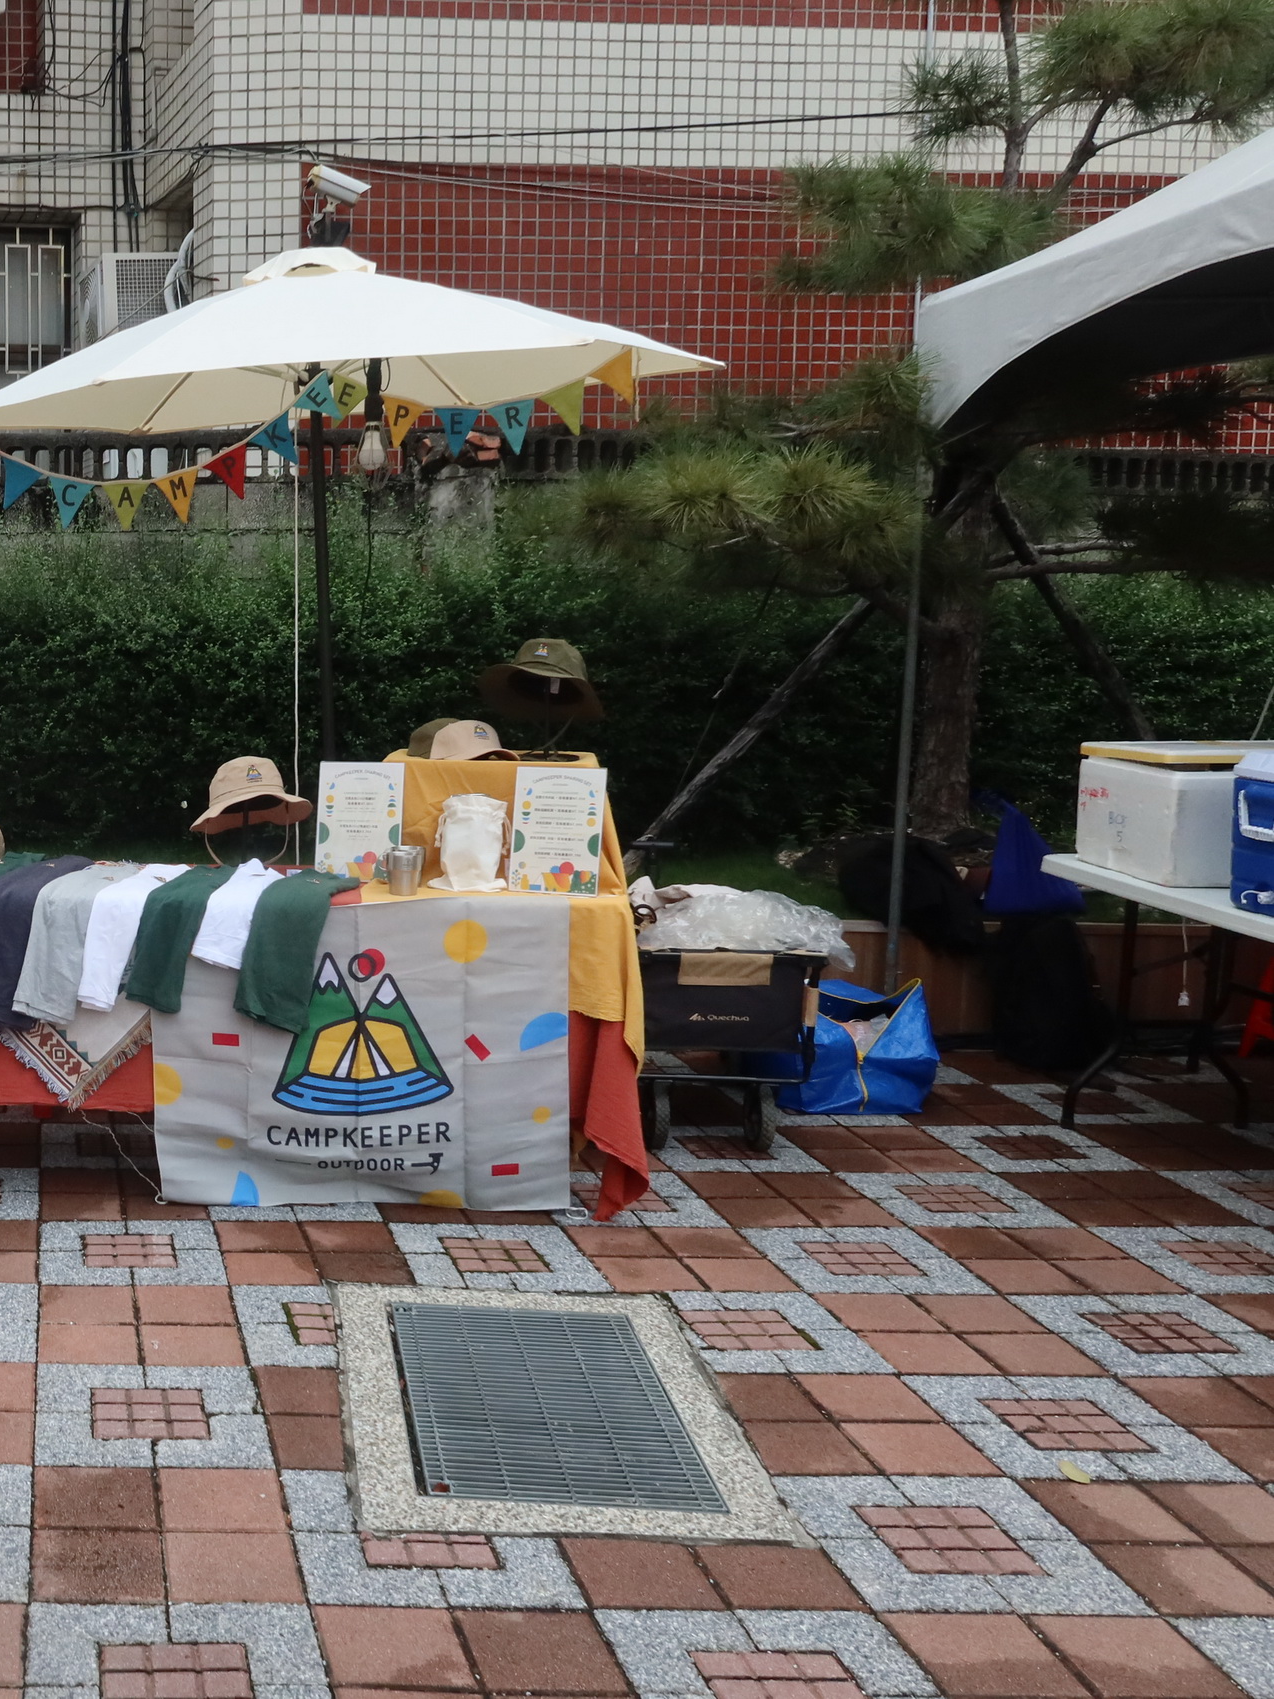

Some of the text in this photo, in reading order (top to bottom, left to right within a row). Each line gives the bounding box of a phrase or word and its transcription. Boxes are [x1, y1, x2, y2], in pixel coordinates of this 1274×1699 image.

[1116, 830, 1123, 843] 5
[707, 1014, 750, 1022] Quechua
[267, 1121, 452, 1149] CAMPKEEPER
[317, 1157, 406, 1172] OUTDOOR
